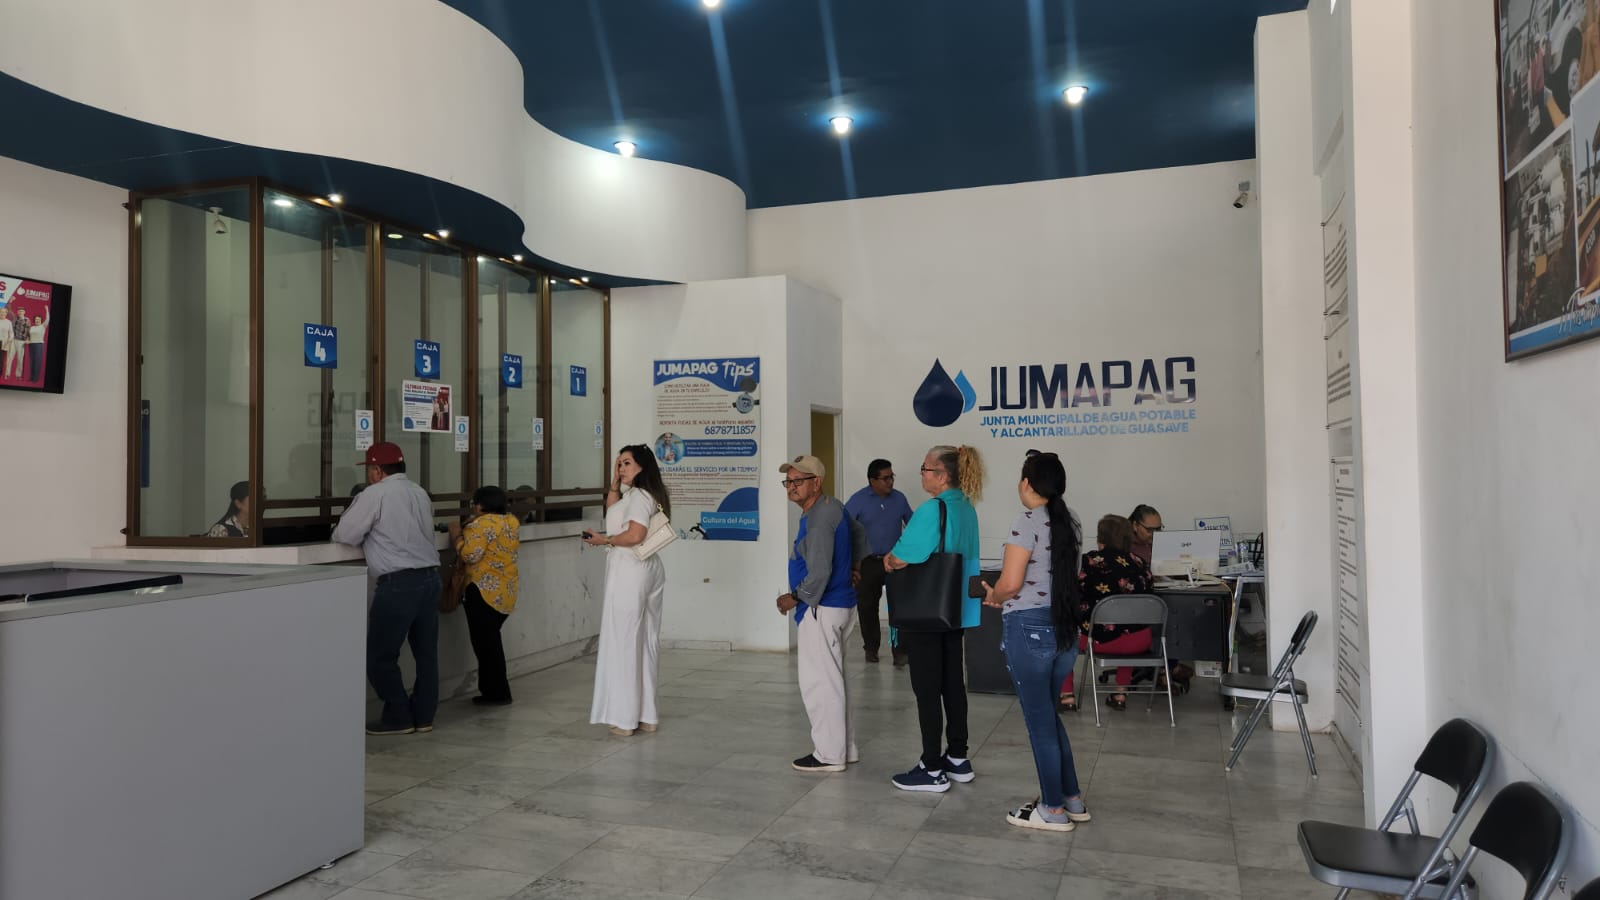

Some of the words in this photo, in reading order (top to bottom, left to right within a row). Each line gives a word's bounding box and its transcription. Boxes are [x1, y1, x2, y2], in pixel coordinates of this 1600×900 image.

[306, 326, 335, 338] CAJA
[314, 341, 327, 362] 4
[416, 342, 438, 352] CAJA
[422, 354, 432, 373] 3
[503, 355, 521, 364] CAJA
[508, 366, 516, 383] 2
[571, 367, 585, 375] CAJA
[657, 361, 719, 376] JUMAPAG
[722, 360, 756, 388] Tips
[575, 377, 581, 392] 1
[978, 356, 1197, 412] JUMAPAG
[980, 416, 1016, 426] JUNTA
[1018, 413, 1083, 425] MUNICIPAL
[1083, 413, 1099, 423] DE
[1101, 411, 1138, 422] AGUA
[1139, 409, 1197, 421] POTABLE
[704, 425, 756, 435] 6878711857
[990, 429, 998, 438] Y
[1000, 425, 1109, 438] ALCANTARILLADO
[1110, 425, 1126, 435] DE
[1128, 422, 1189, 434] GUASAVE
[702, 516, 727, 524] Cultura
[727, 516, 738, 524] del
[738, 517, 756, 525] Agua
